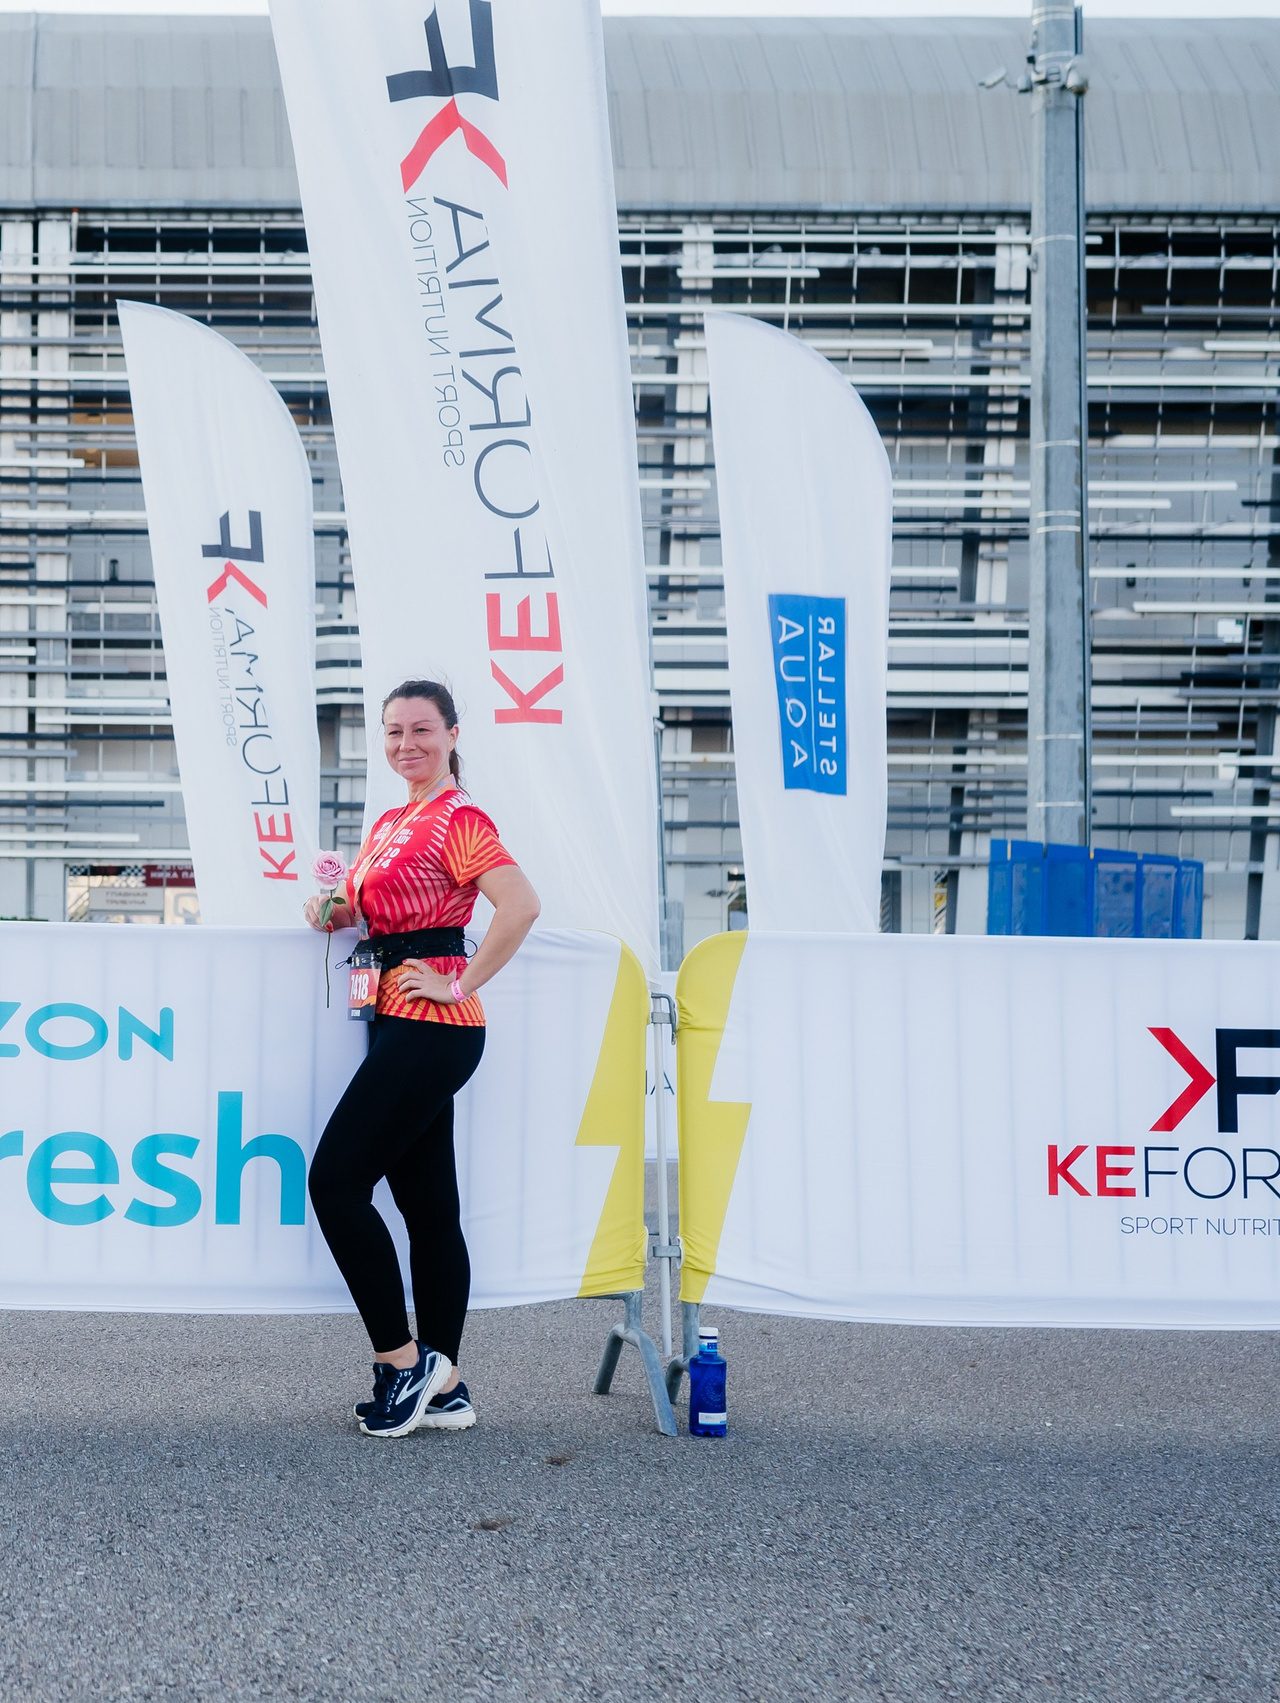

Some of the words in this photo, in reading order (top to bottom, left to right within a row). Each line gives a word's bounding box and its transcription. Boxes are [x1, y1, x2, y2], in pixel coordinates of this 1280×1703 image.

[382, 846, 401, 858] 20
[373, 857, 393, 869] 24
[1120, 1216, 1199, 1236] SPORT
